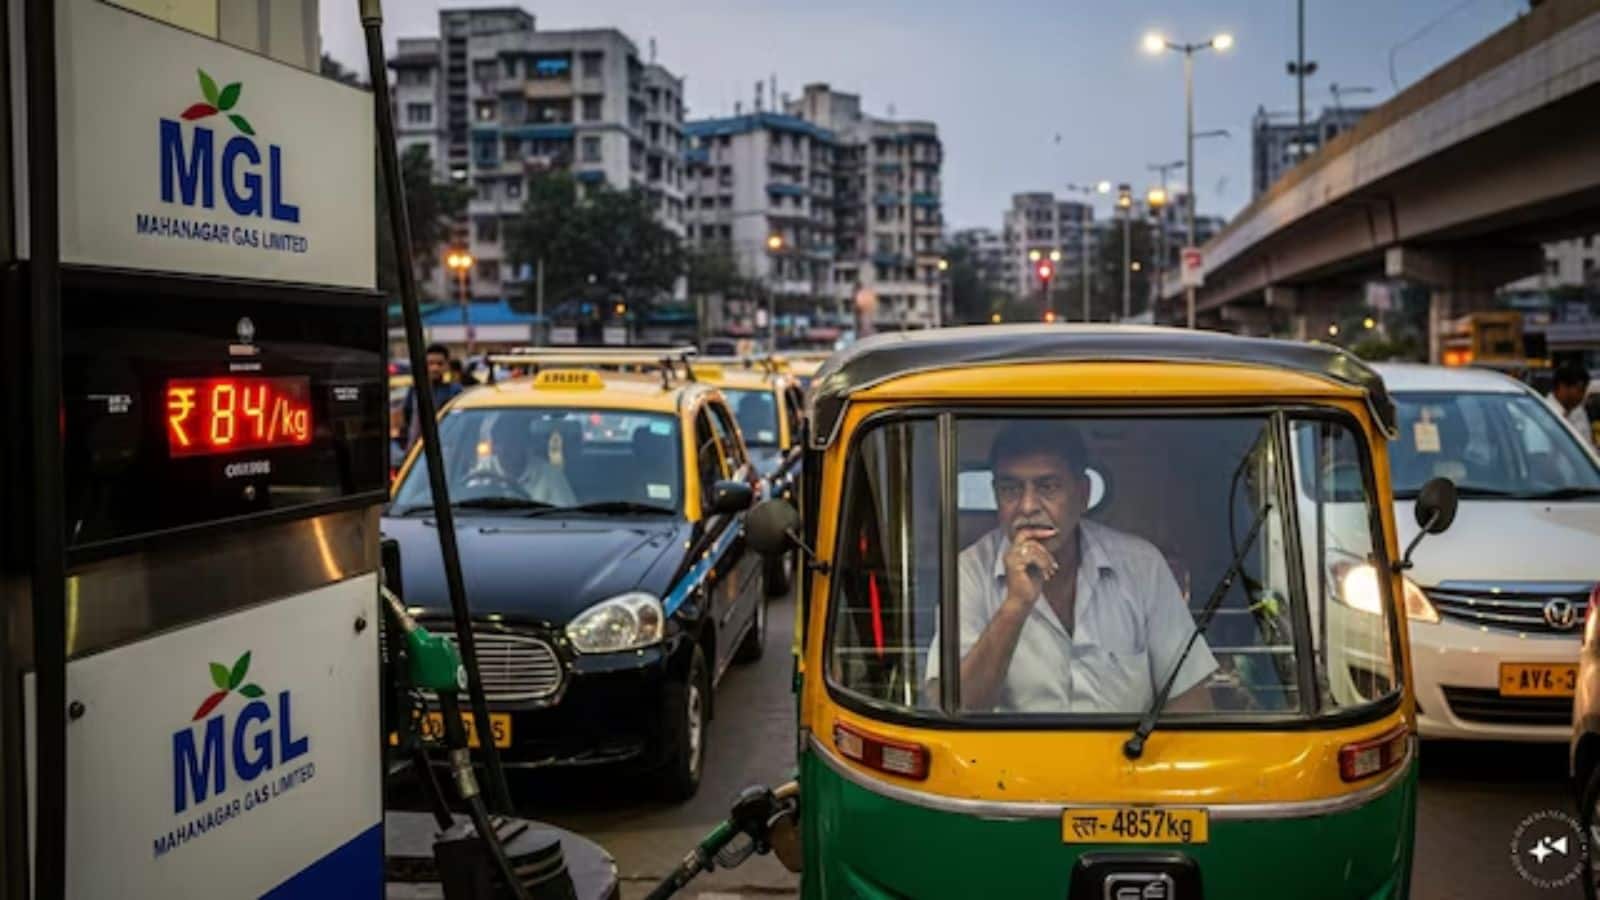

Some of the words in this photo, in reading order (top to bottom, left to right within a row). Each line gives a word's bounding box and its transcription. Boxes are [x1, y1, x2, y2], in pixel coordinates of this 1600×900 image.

[160, 118, 300, 223] MGL
[136, 213, 230, 243] MAHANAGAR
[232, 227, 259, 248] GAS
[262, 232, 308, 253] LIMITED
[172, 690, 309, 815] MGL
[153, 799, 241, 859] MAHANAGAR
[244, 783, 269, 811] GAS
[272, 762, 316, 797] LIMITED
